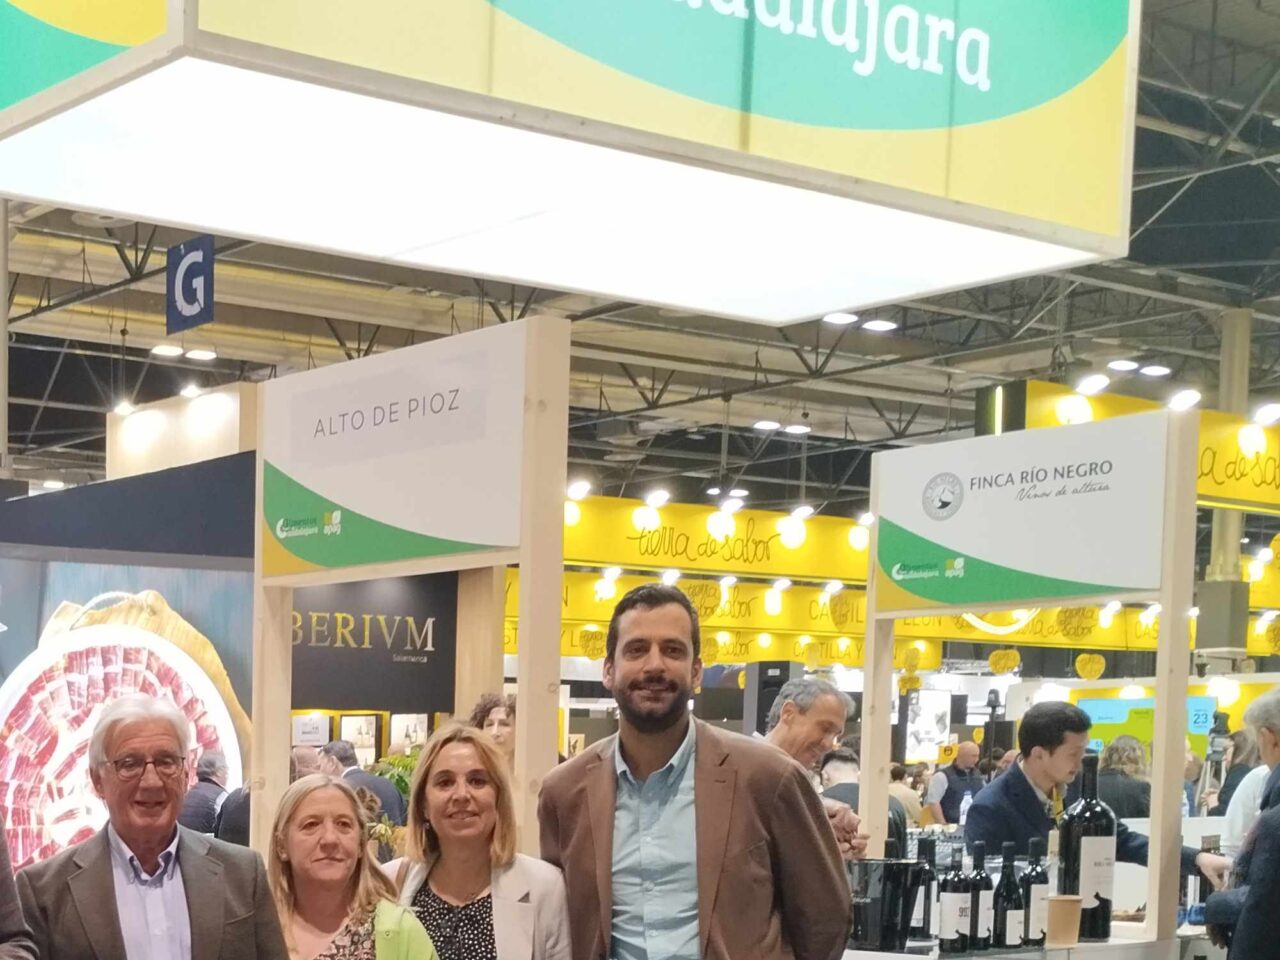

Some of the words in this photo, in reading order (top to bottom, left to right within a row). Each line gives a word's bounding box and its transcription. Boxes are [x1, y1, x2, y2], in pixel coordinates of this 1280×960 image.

[174, 249, 205, 317] G
[313, 409, 365, 438] ALTO
[373, 401, 399, 427] DE
[407, 388, 460, 419] PIOZ
[969, 472, 1015, 491] FINCA
[1020, 465, 1048, 484] RÍO
[1053, 459, 1113, 481] NEGRO
[719, 517, 781, 564] sabor
